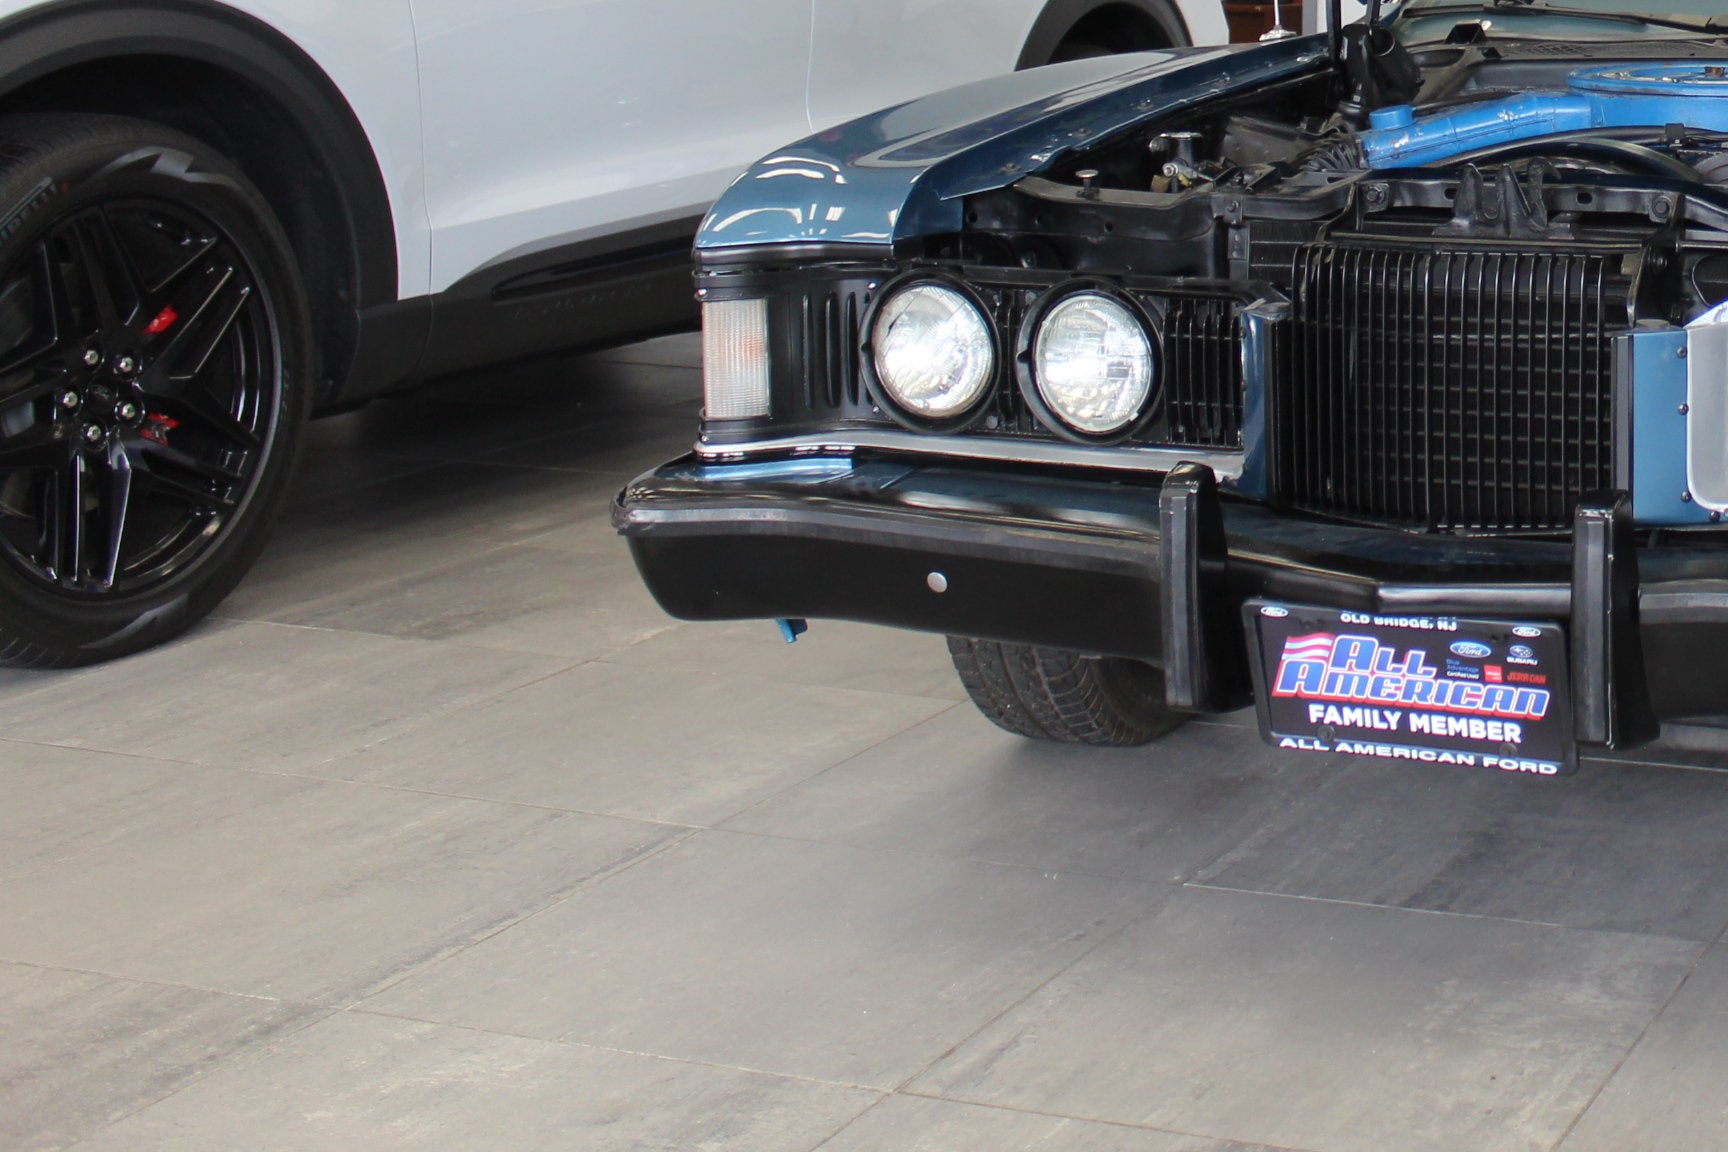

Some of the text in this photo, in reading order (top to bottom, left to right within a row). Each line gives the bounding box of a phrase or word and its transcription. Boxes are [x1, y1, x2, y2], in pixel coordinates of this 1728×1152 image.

[1340, 612, 1370, 625] OLD
[1437, 619, 1457, 632] NJ
[1329, 634, 1437, 678] ALL
[1273, 659, 1550, 718] AMERICAN
[1308, 703, 1522, 744] FAMILY MEMBER
[1279, 737, 1559, 776] ALL AMERICAN FORD
